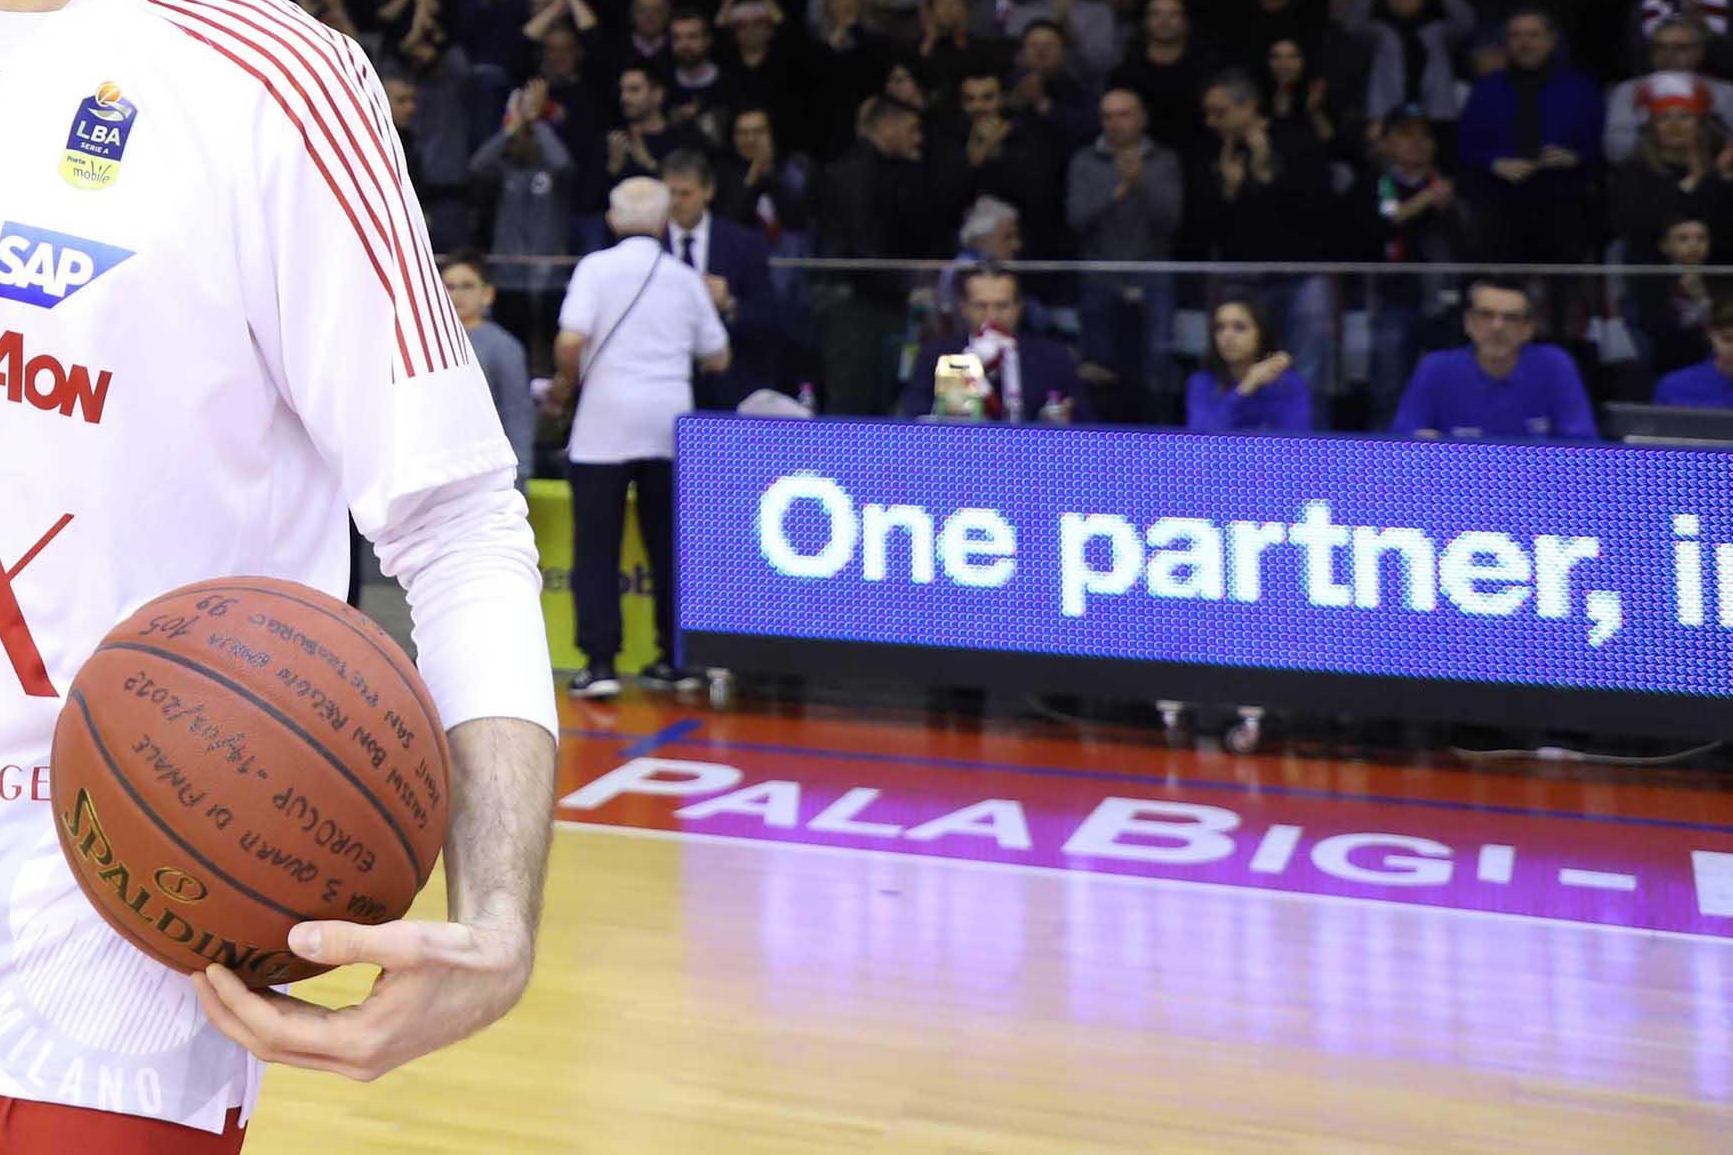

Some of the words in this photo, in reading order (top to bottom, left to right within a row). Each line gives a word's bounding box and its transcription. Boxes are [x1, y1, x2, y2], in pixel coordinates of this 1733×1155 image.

[76, 120, 121, 147] LBA
[80, 141, 103, 153] SERIE
[757, 470, 1016, 587] One
[1060, 498, 1624, 647] partner,
[138, 613, 201, 639] 105
[195, 594, 241, 618] 99
[351, 724, 387, 769] BON
[383, 709, 415, 750] SAN
[131, 733, 209, 808] FINALE
[205, 803, 234, 830] DI
[272, 787, 376, 874] EUROCUP
[61, 787, 300, 982] SPALDING
